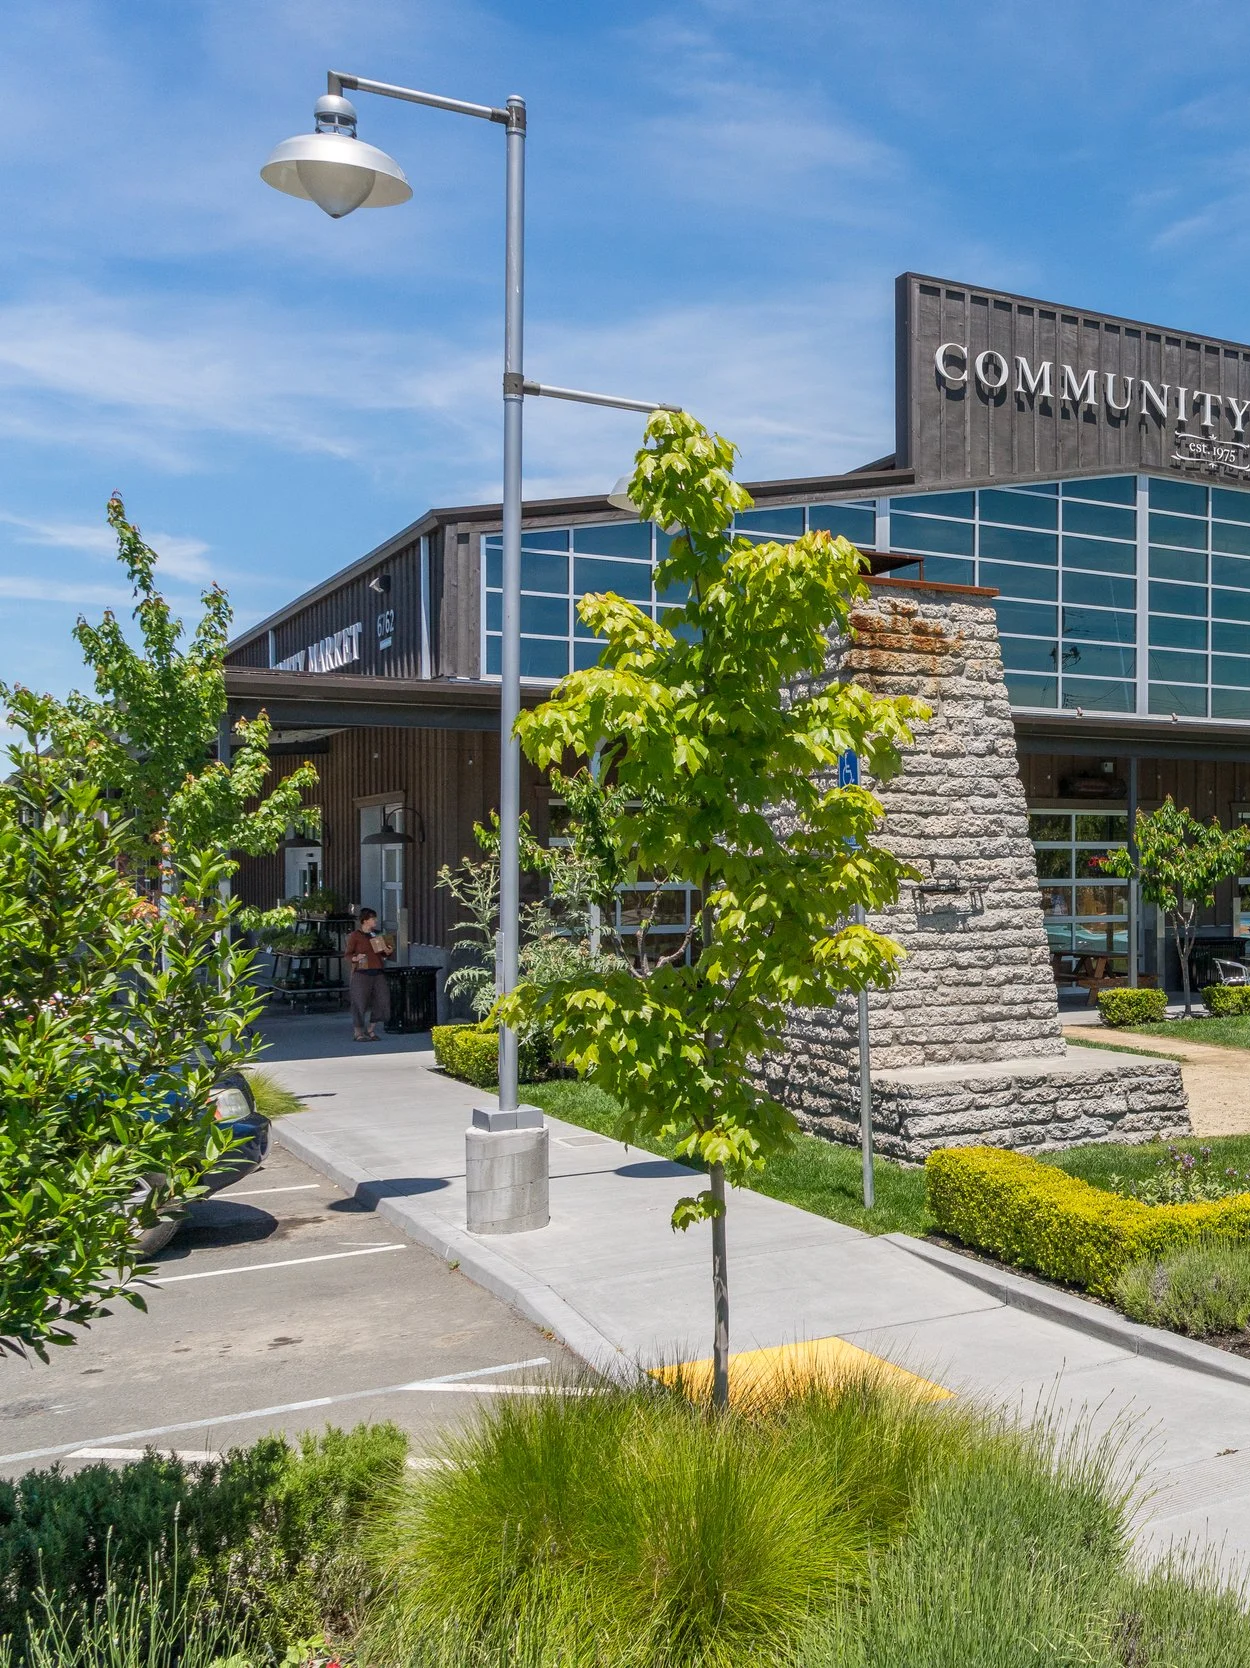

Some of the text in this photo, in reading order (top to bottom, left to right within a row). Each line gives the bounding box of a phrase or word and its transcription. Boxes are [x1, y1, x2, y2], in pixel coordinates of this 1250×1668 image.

[1189, 443, 1236, 462] est. 1975
[377, 610, 394, 637] 6762
[308, 622, 362, 672] MARKET
